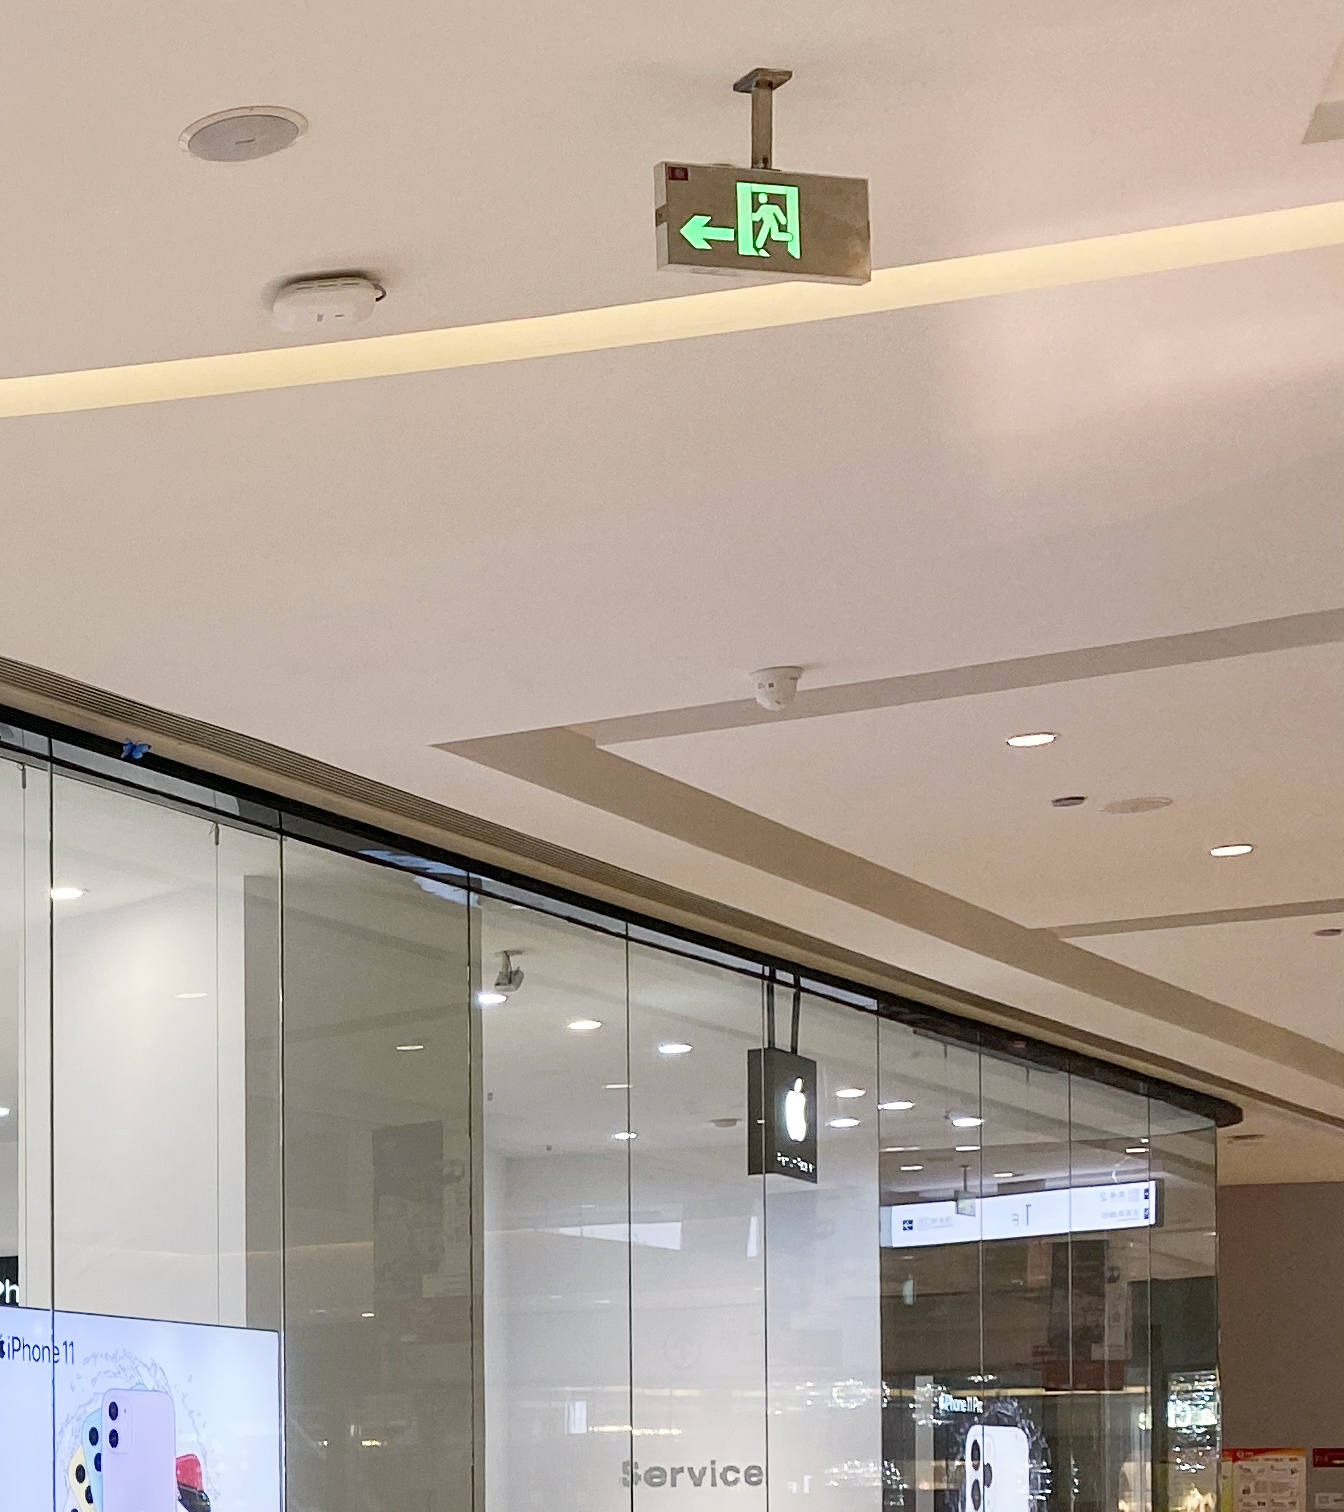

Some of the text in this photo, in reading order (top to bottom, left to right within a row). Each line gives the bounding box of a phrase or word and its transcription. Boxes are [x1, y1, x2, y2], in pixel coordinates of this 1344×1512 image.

[7, 1335, 75, 1366] iPhone 11
[621, 1459, 764, 1488] Service
